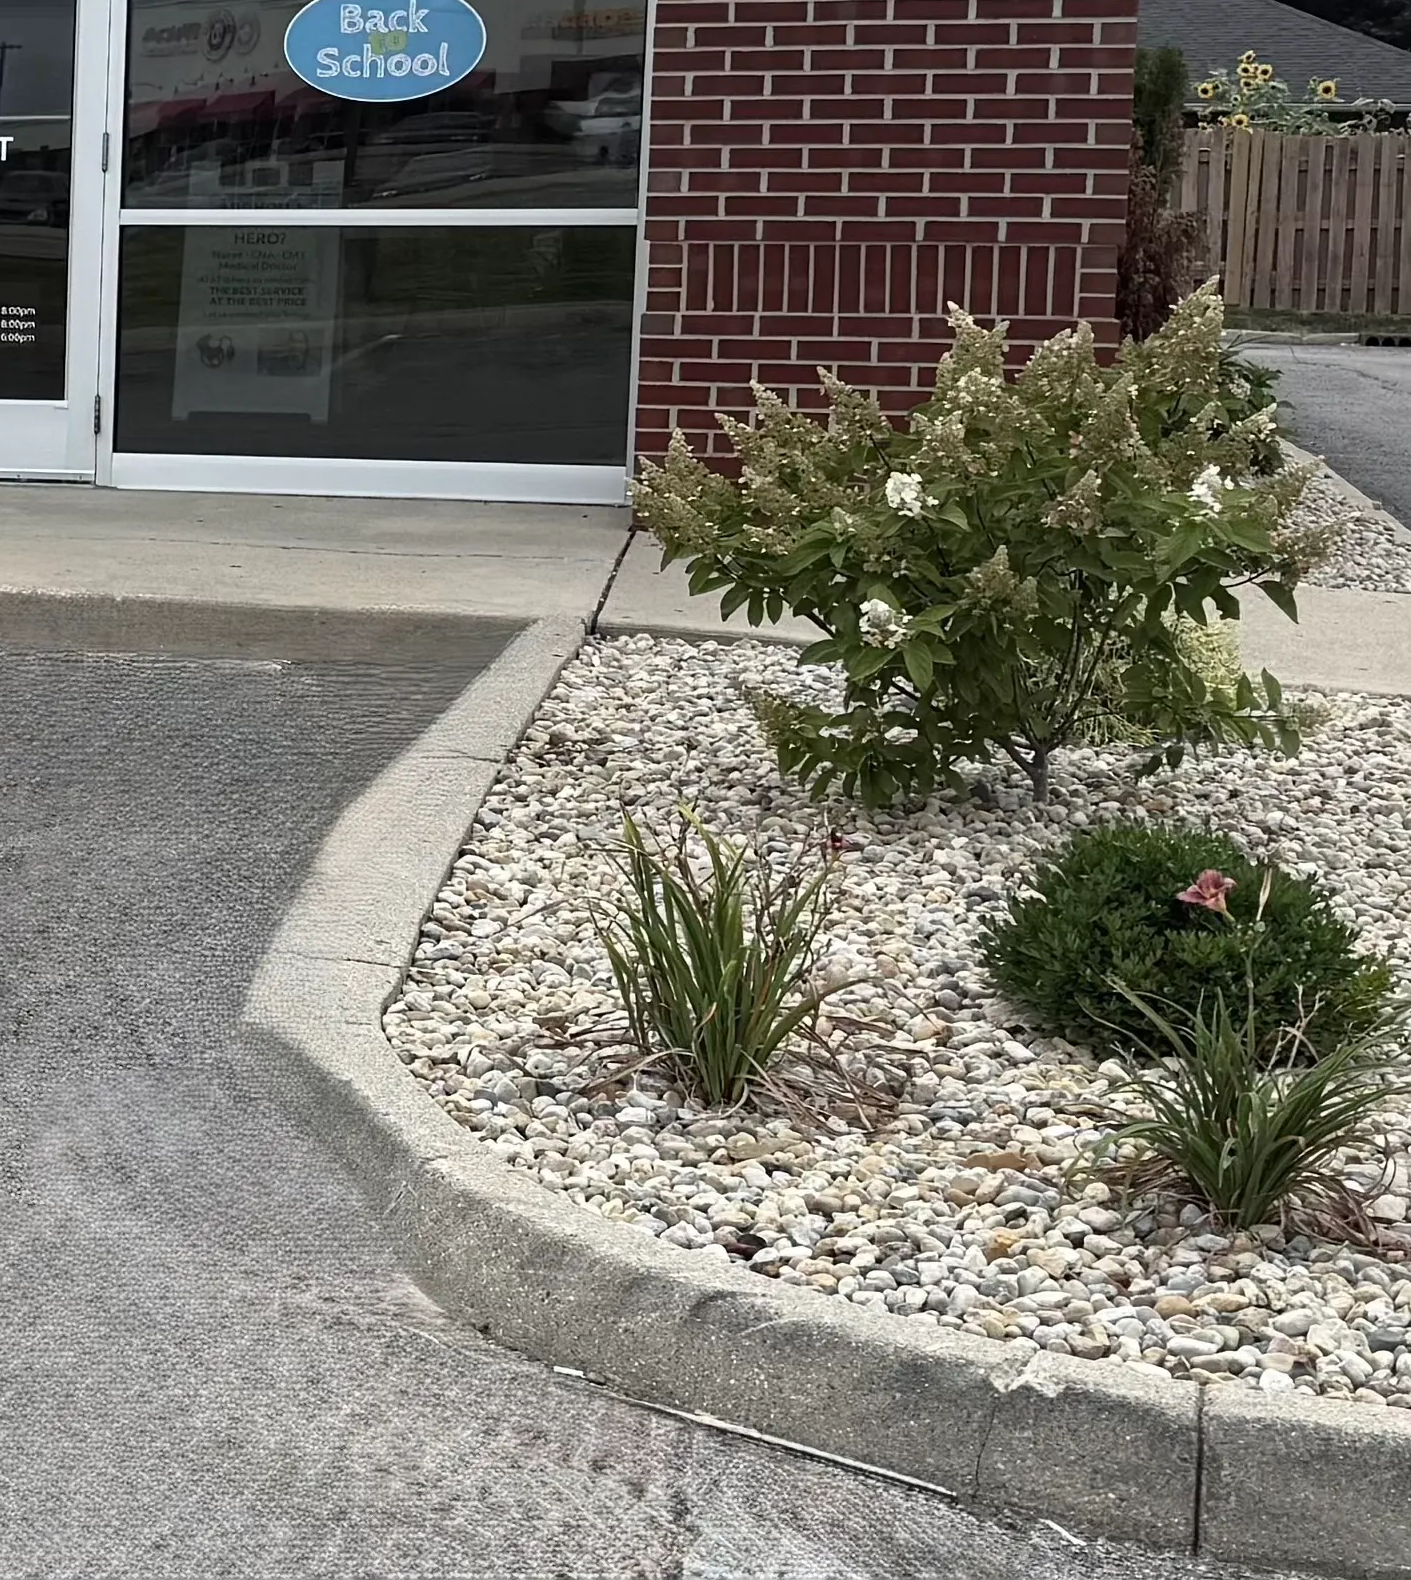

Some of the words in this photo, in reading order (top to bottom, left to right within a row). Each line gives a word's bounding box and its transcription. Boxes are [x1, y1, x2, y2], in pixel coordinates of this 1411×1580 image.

[369, 30, 408, 54] to
[316, 42, 451, 78] School
[234, 232, 287, 245] HERO?
